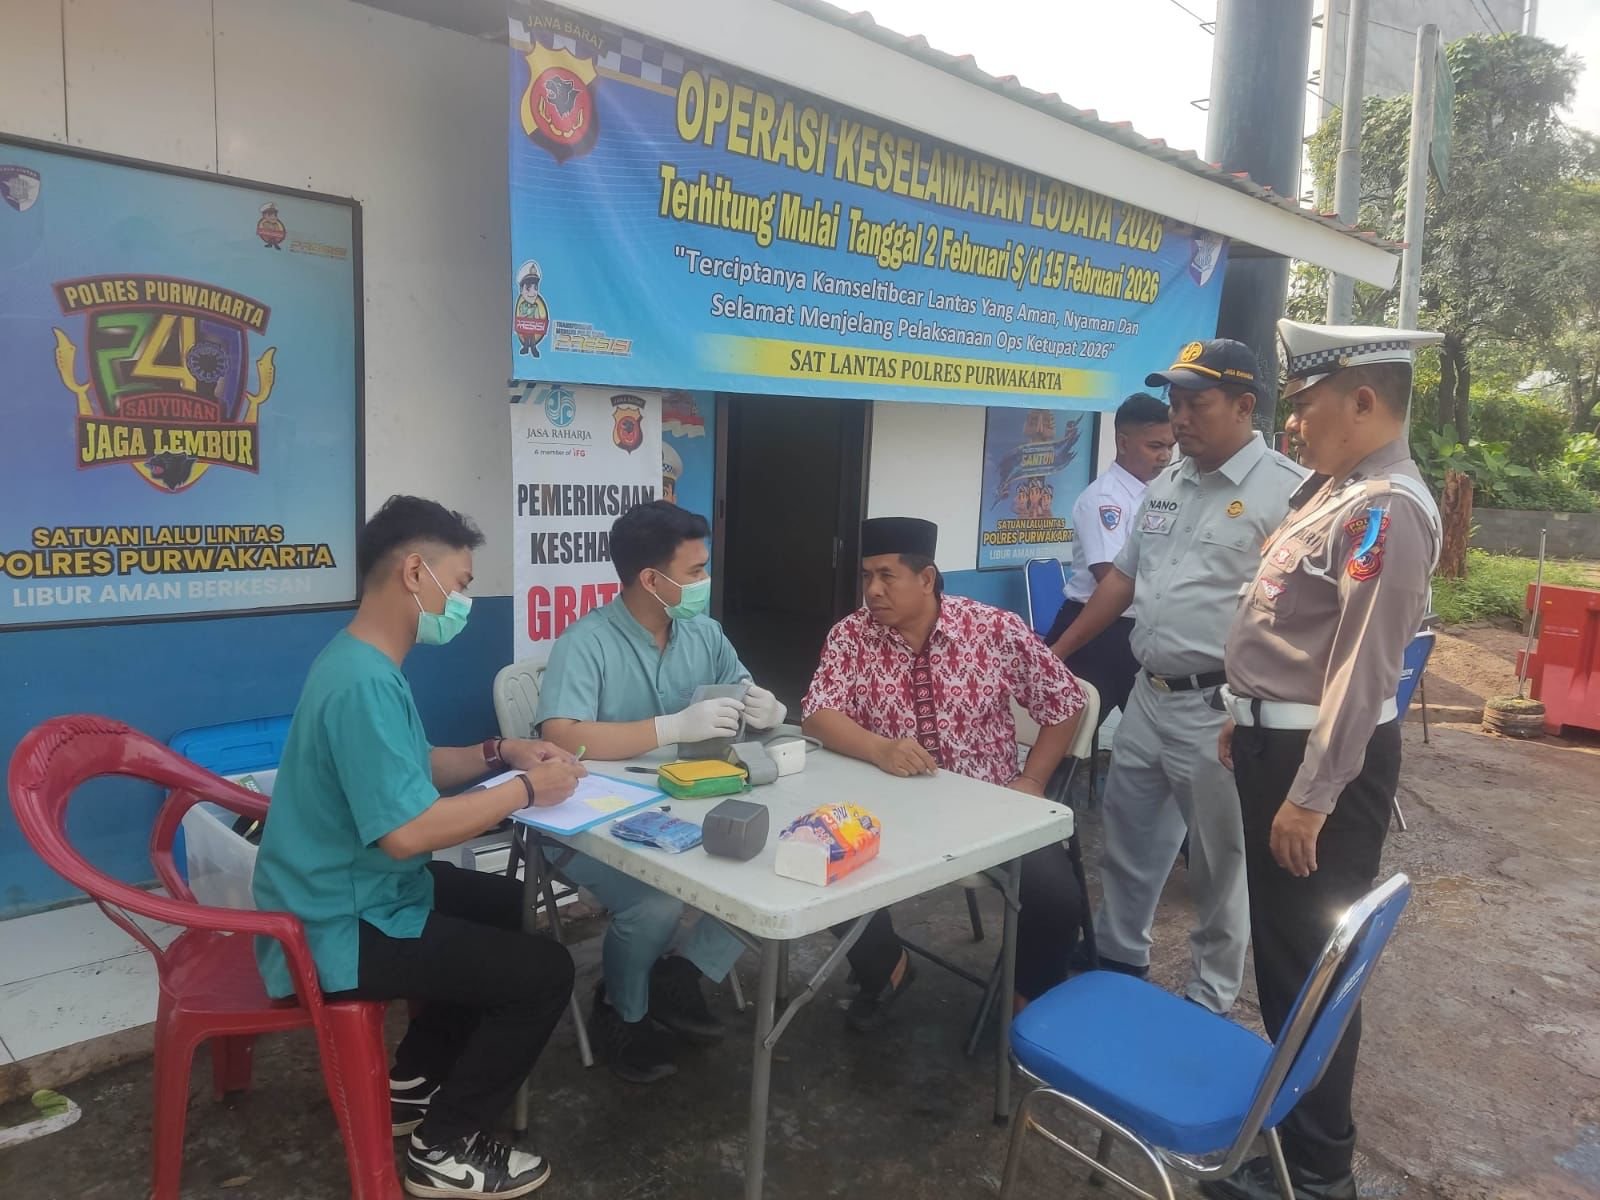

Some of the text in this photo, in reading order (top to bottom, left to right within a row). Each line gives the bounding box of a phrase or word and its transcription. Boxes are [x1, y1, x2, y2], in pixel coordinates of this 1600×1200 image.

[527, 15, 561, 31] JAWA
[676, 70, 1164, 254] OPERASI KESELAMATAN LODAYA 2026
[659, 163, 1161, 304] Terhitung Mulai Tanggal 2 Februari S/d 15 Februari 2026
[63, 279, 265, 328] POLRES PURWAKARTA
[674, 245, 1139, 337] "Terciptanya Kamseltibcar Lantas Yang Aman, Nyaman Dan
[711, 293, 795, 325] Selamat
[799, 304, 894, 341] Menjelang
[896, 319, 993, 348] Pelaksanaan
[995, 331, 1023, 353] Ops
[1026, 332, 1079, 358] Ketupat
[789, 348, 1063, 391] SAT LANTAS POLRES PURWAKARTA
[81, 421, 253, 466] JAGA LEMBUR
[527, 428, 592, 441] JASA RAHARJA
[517, 483, 656, 517] PEMERIKSAAN
[1149, 499, 1178, 511] NANO
[33, 525, 285, 548] SATUAN LALU LINTAS
[983, 527, 1073, 545] POLRES PURWAKART
[997, 519, 1026, 530] SATUAN
[1026, 519, 1042, 529] LALU
[119, 546, 335, 573] PURWAKARTA
[12, 576, 312, 609] LIBUR AMAN BERKESAN
